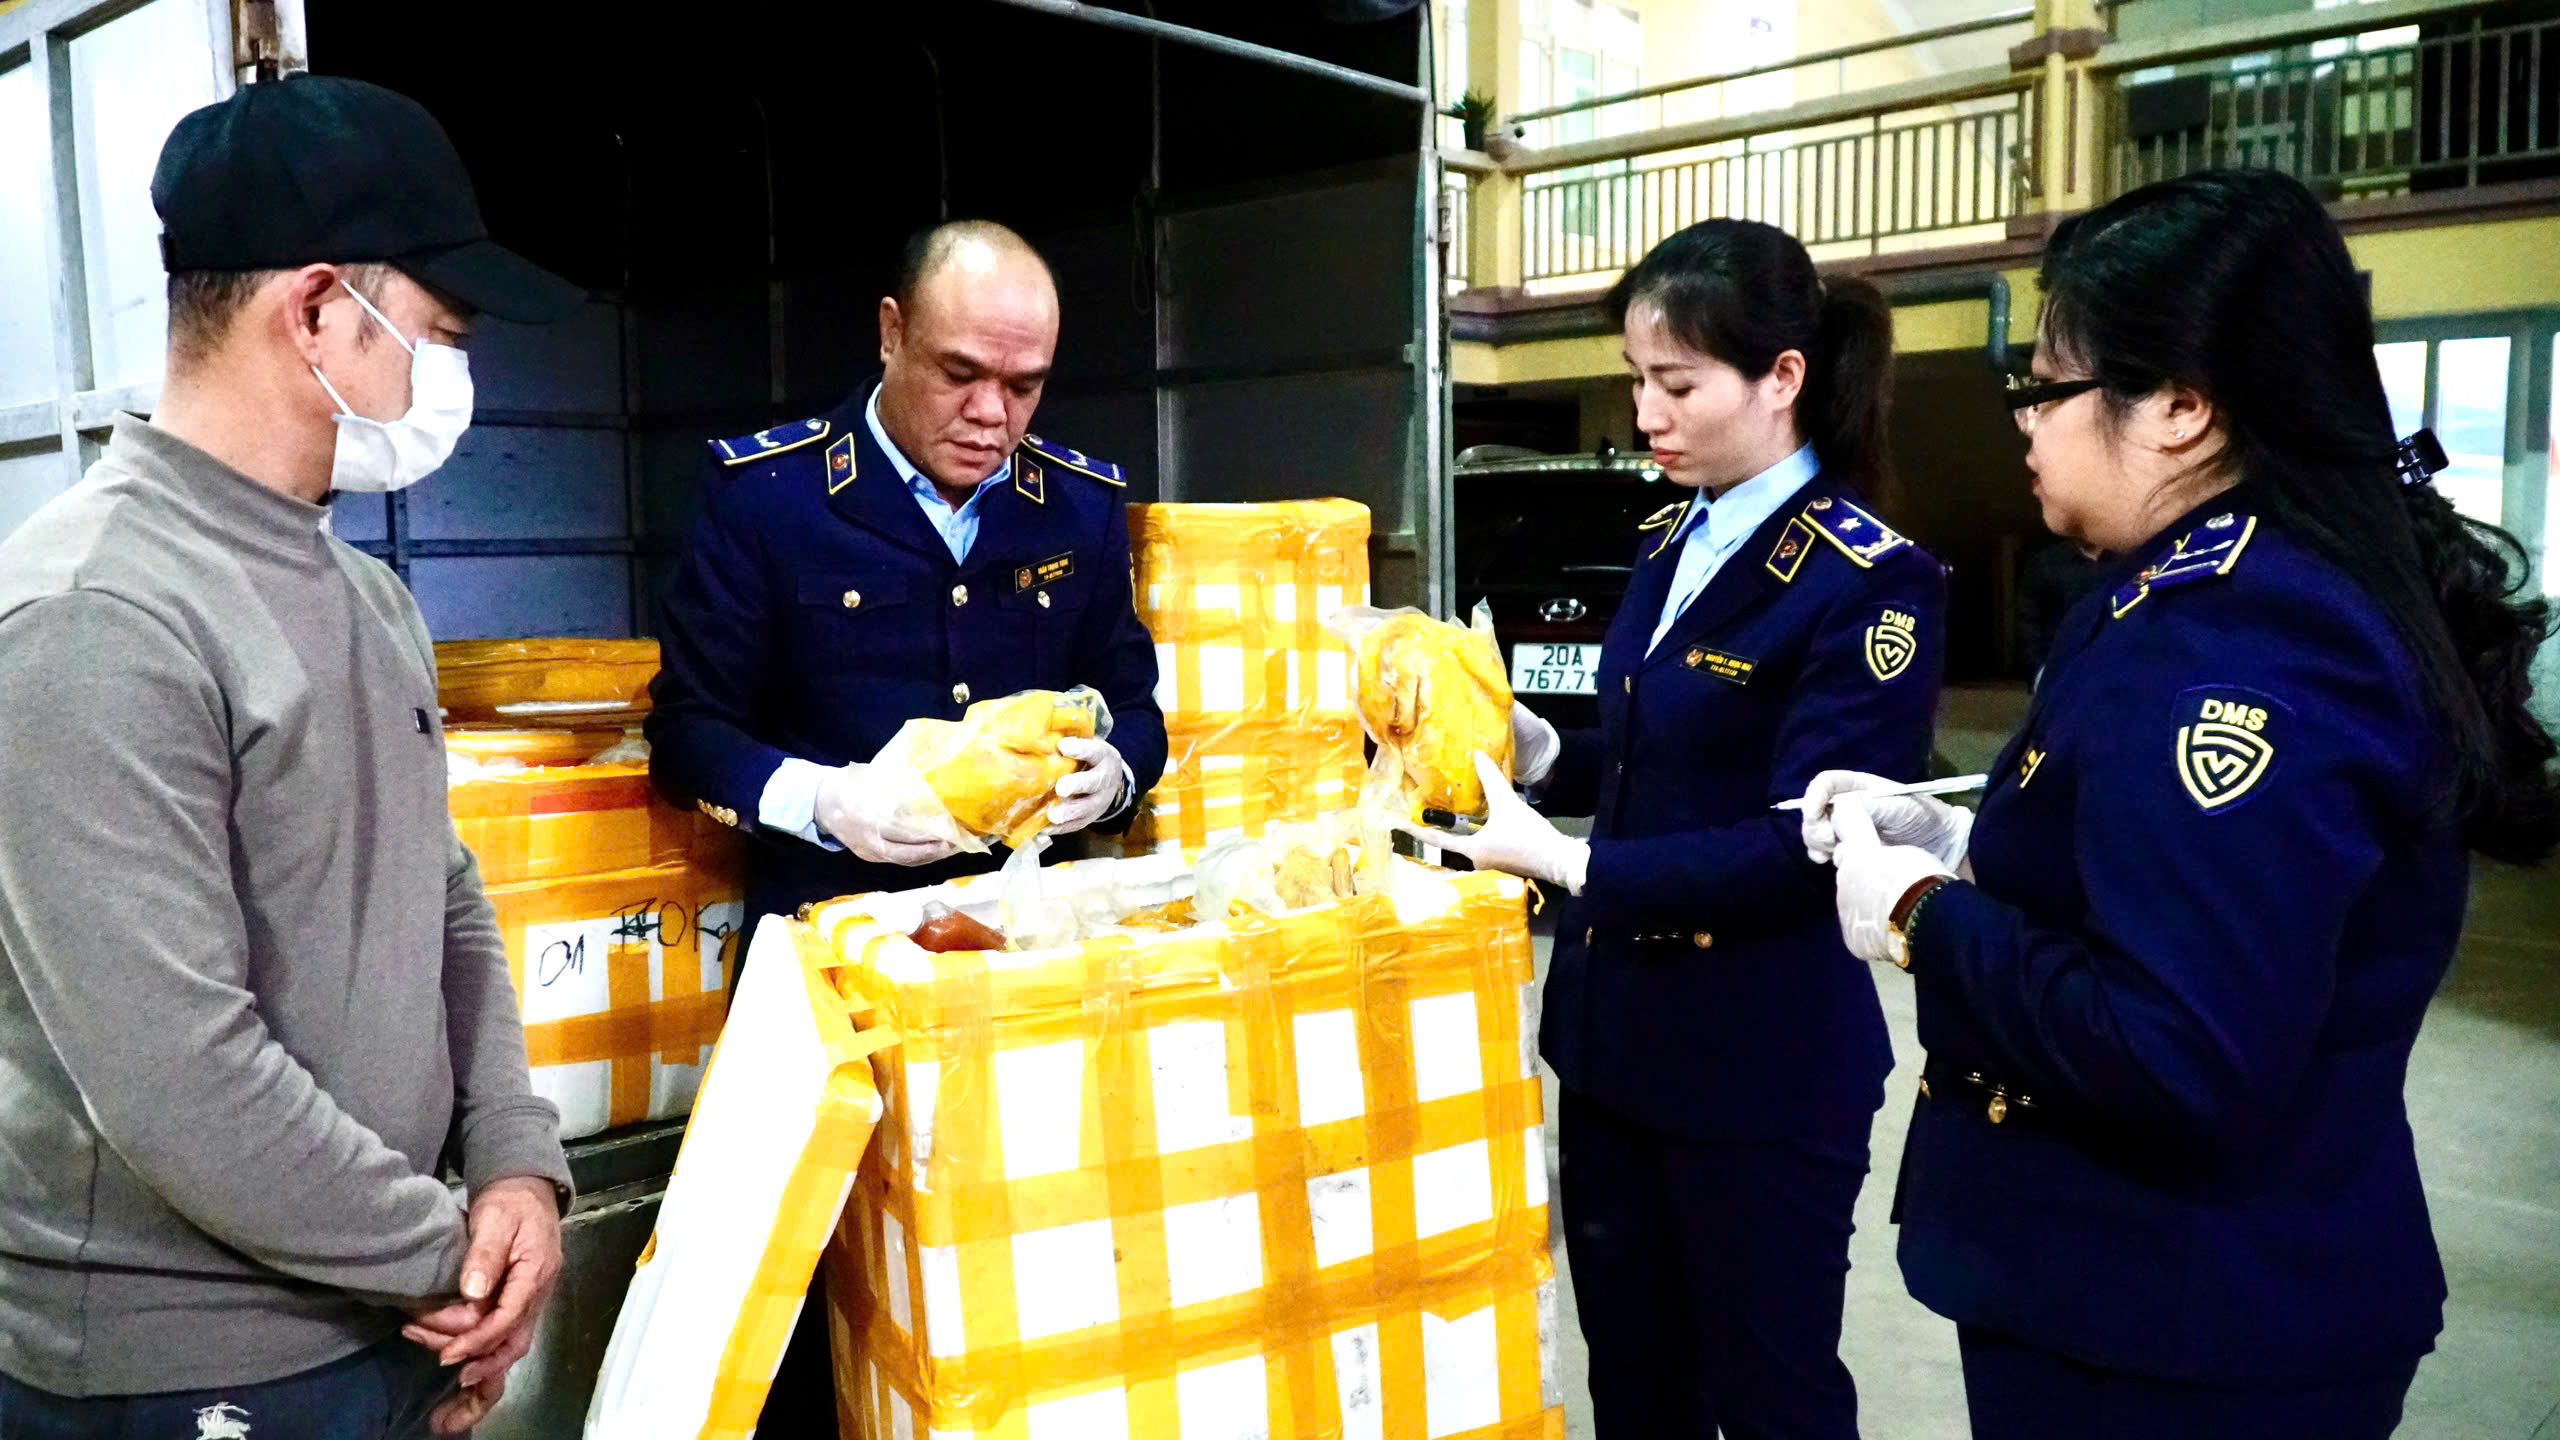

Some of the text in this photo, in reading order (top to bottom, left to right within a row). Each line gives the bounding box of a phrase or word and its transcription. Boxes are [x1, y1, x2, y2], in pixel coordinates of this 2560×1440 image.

[1881, 609, 1916, 632] DMS
[1542, 645, 1583, 666] 20A
[2200, 698, 2268, 731] DMS
